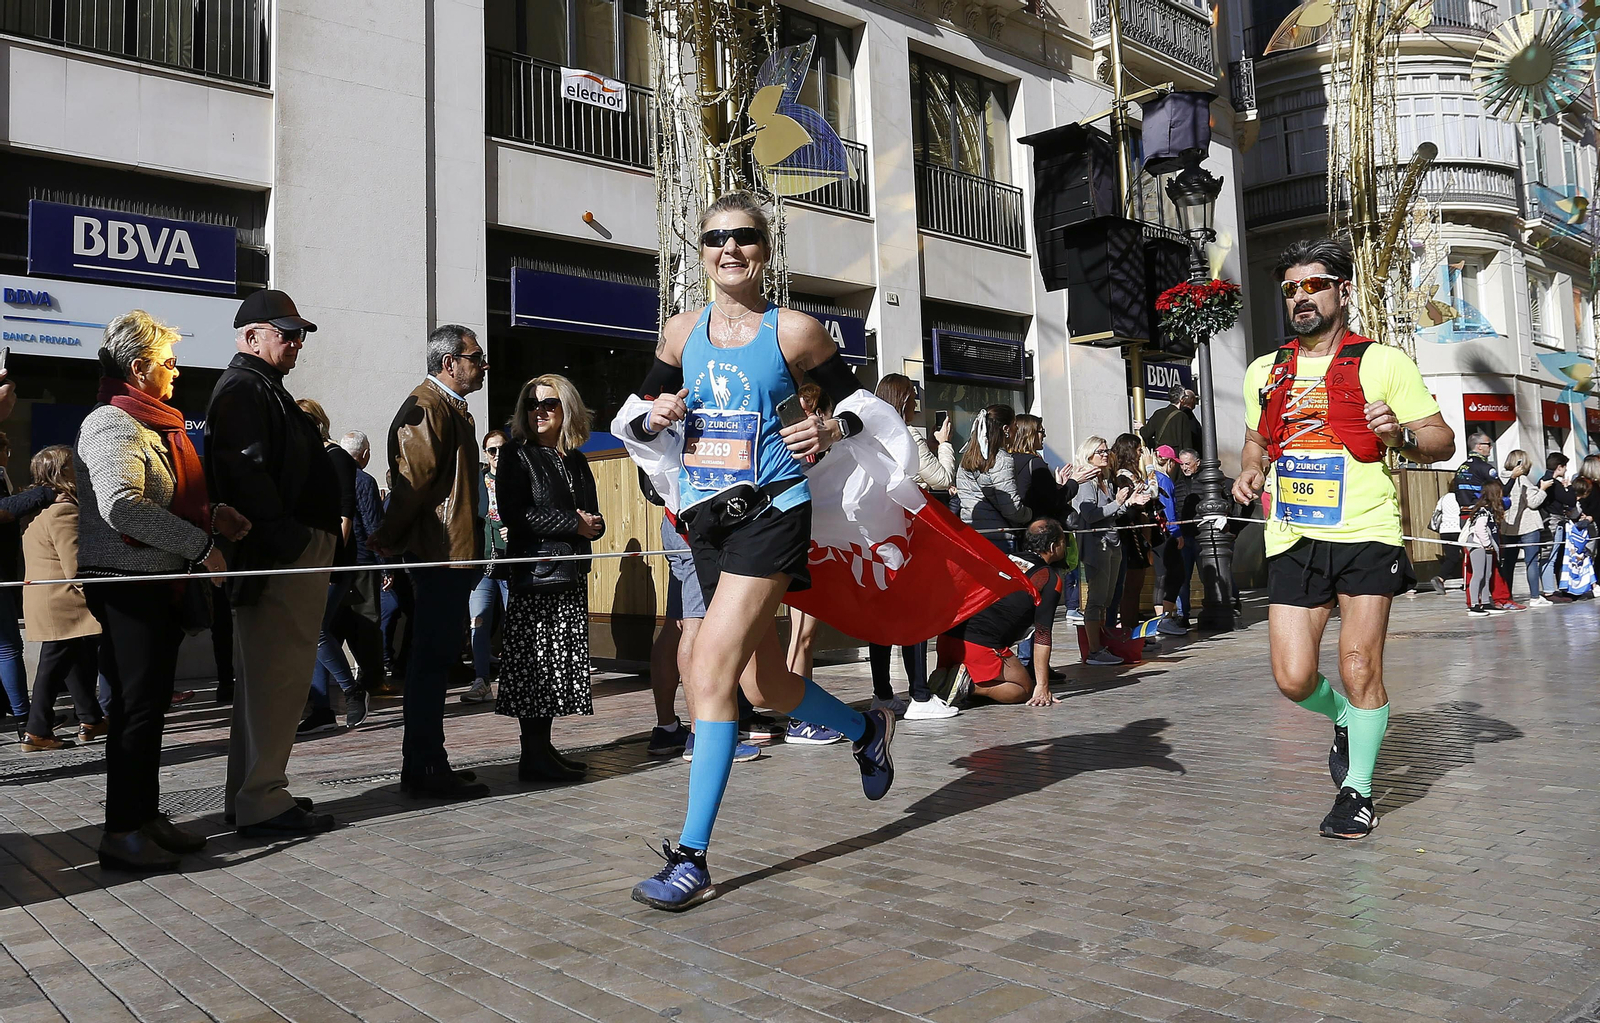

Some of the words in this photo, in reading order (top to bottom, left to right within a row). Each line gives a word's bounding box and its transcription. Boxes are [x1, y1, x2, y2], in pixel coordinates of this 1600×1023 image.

[567, 83, 622, 107] elecnor
[73, 215, 200, 269] BBVA
[4, 287, 52, 306] BBVA
[3, 331, 38, 343] BANCA
[39, 335, 81, 346] PRIVADA
[718, 363, 738, 373] TCS
[737, 371, 751, 391] NEW
[1146, 364, 1182, 388] BBVA
[1477, 403, 1509, 412] Santander
[708, 421, 738, 429] ZURICH
[697, 442, 731, 457] 2269
[1296, 462, 1326, 471] ZURICH
[1292, 482, 1314, 495] 986
